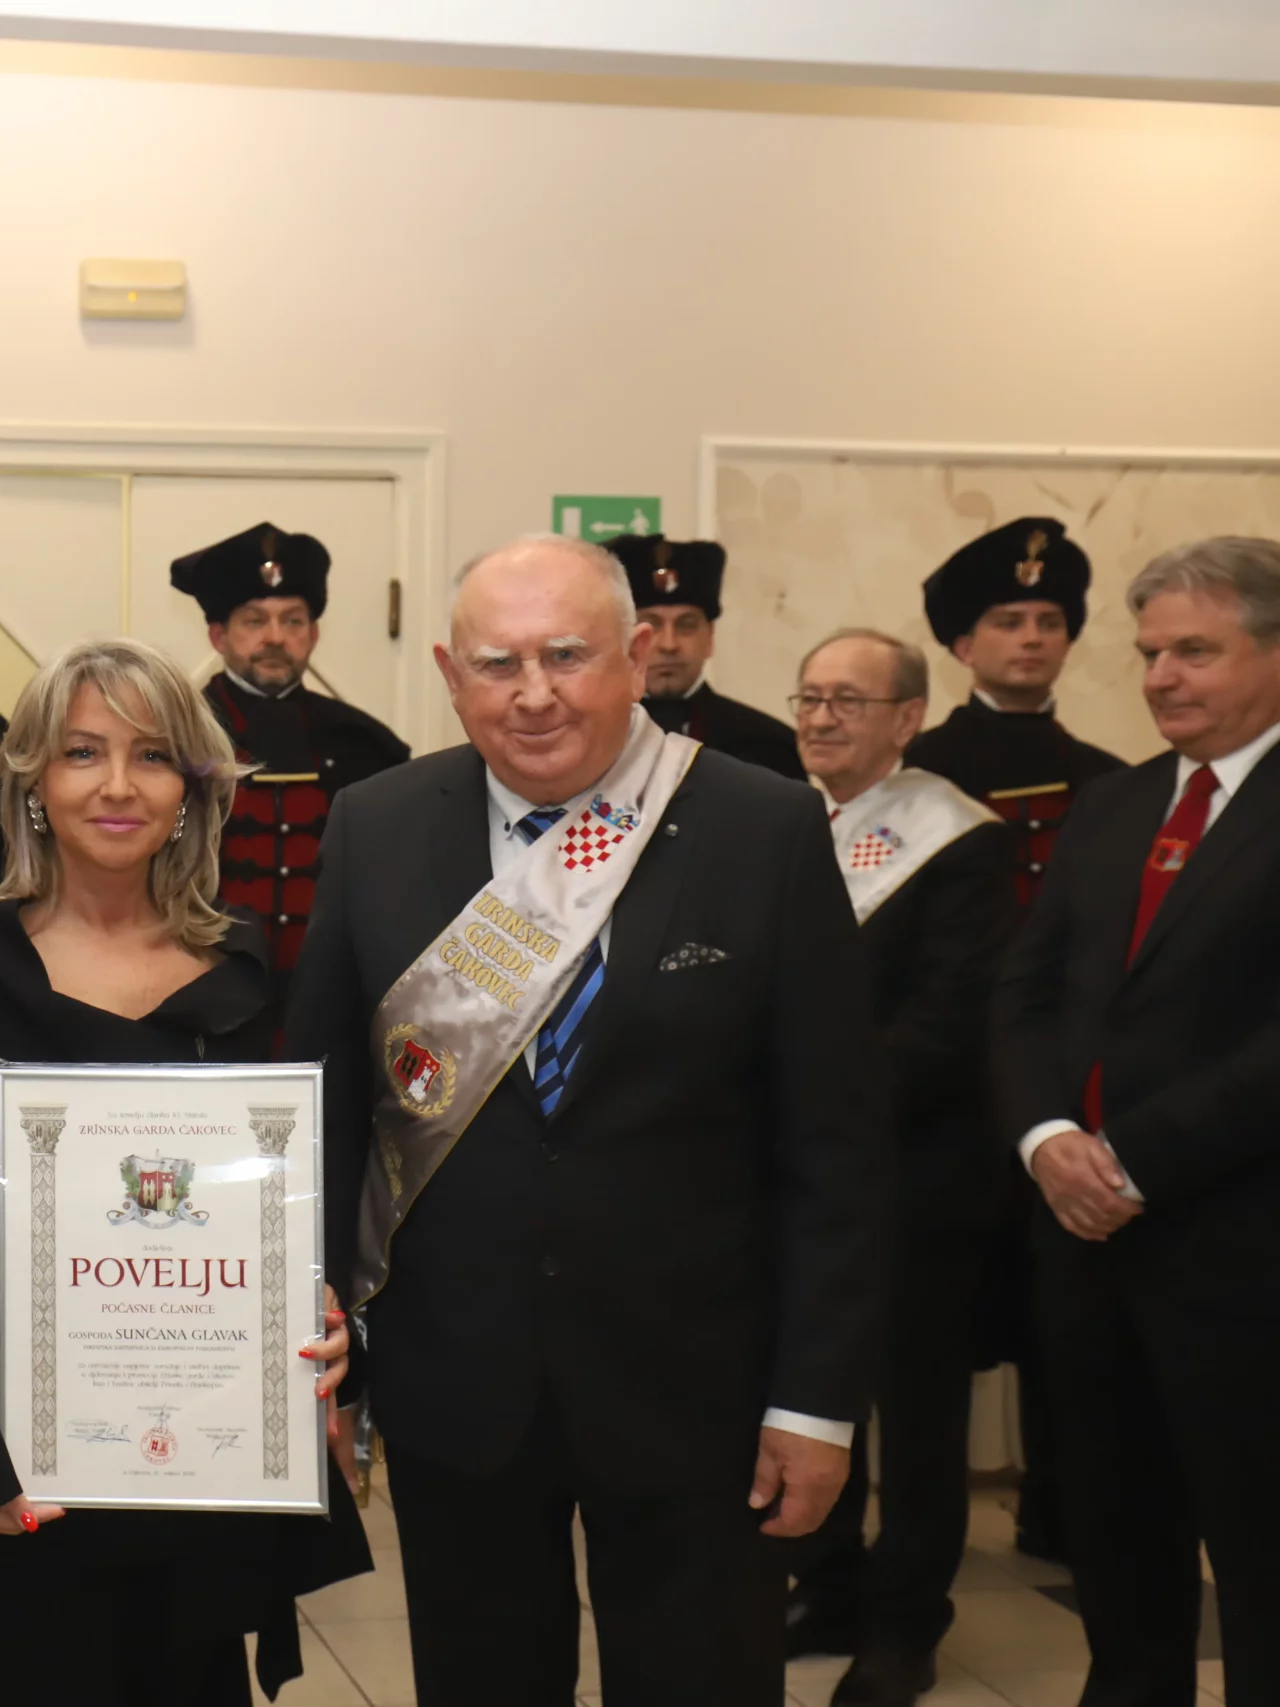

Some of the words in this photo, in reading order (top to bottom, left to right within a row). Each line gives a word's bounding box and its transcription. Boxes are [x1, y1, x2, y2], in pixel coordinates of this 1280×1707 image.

[472, 891, 561, 963] ZRINSKA
[464, 922, 537, 982] GARDA
[438, 937, 526, 1010] ČAKOVEC
[79, 1123, 130, 1136] ZRINSKA
[133, 1124, 176, 1136] GARDA
[178, 1123, 237, 1136] ČAKOVEC
[68, 1257, 249, 1298] POVELJU
[101, 1302, 156, 1314] POČASNE
[160, 1302, 216, 1314] ČLANICE
[115, 1327, 187, 1341] SUNČANA
[191, 1329, 249, 1341] GLAVAK
